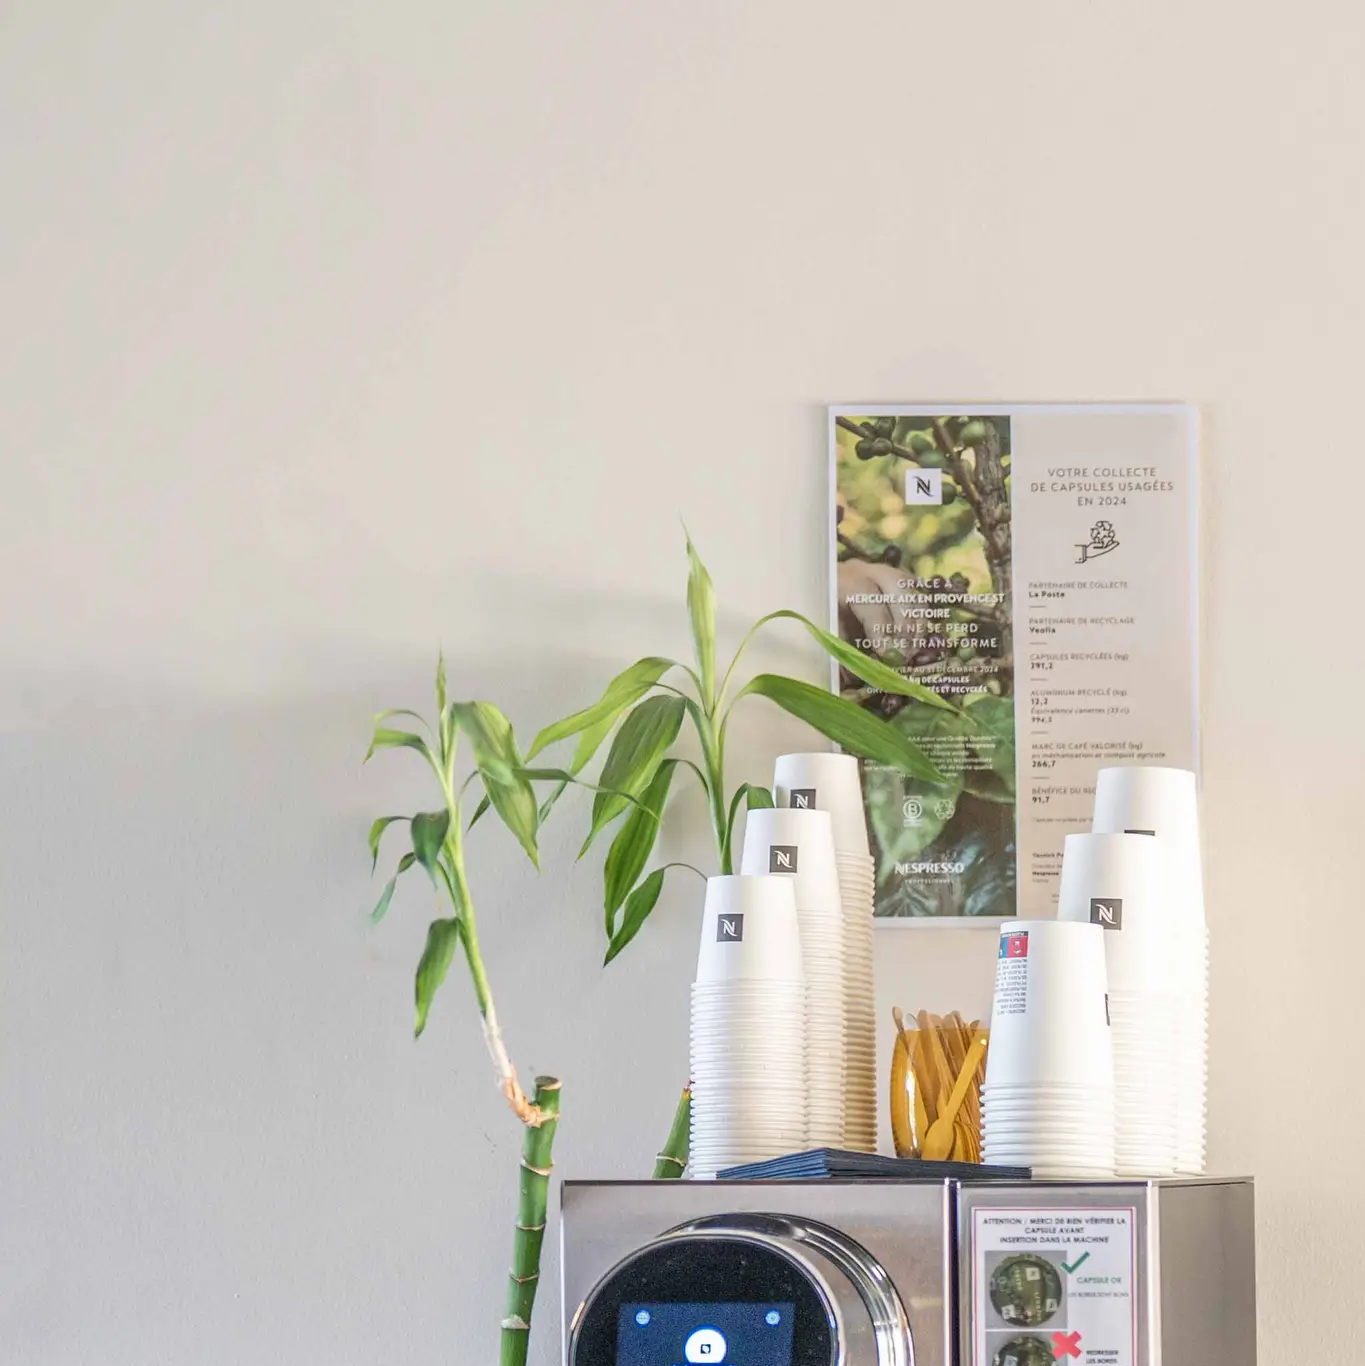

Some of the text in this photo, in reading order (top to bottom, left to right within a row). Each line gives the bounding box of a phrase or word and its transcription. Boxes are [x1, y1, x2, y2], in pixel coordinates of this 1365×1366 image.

[1048, 467, 1157, 477] VOTRE COLLECTE
[1030, 480, 1174, 492] DE CAPSULES USAGÉES
[1078, 497, 1127, 506] EN 2024
[1089, 581, 1128, 589] COLLECTE
[846, 594, 896, 604] MERCURE
[899, 594, 919, 604] AIX
[919, 594, 933, 604] EN
[902, 608, 950, 619] VICTOIRE
[1090, 617, 1135, 625] RECYCLAGE
[873, 622, 978, 634] RIEN NE SE PERD
[855, 638, 998, 649] TOUT SE TRANSFORME
[932, 675, 970, 684] CAPSULES
[894, 860, 965, 876] NESPRESSO
[1085, 1216, 1115, 1225] VÉRIFIER
